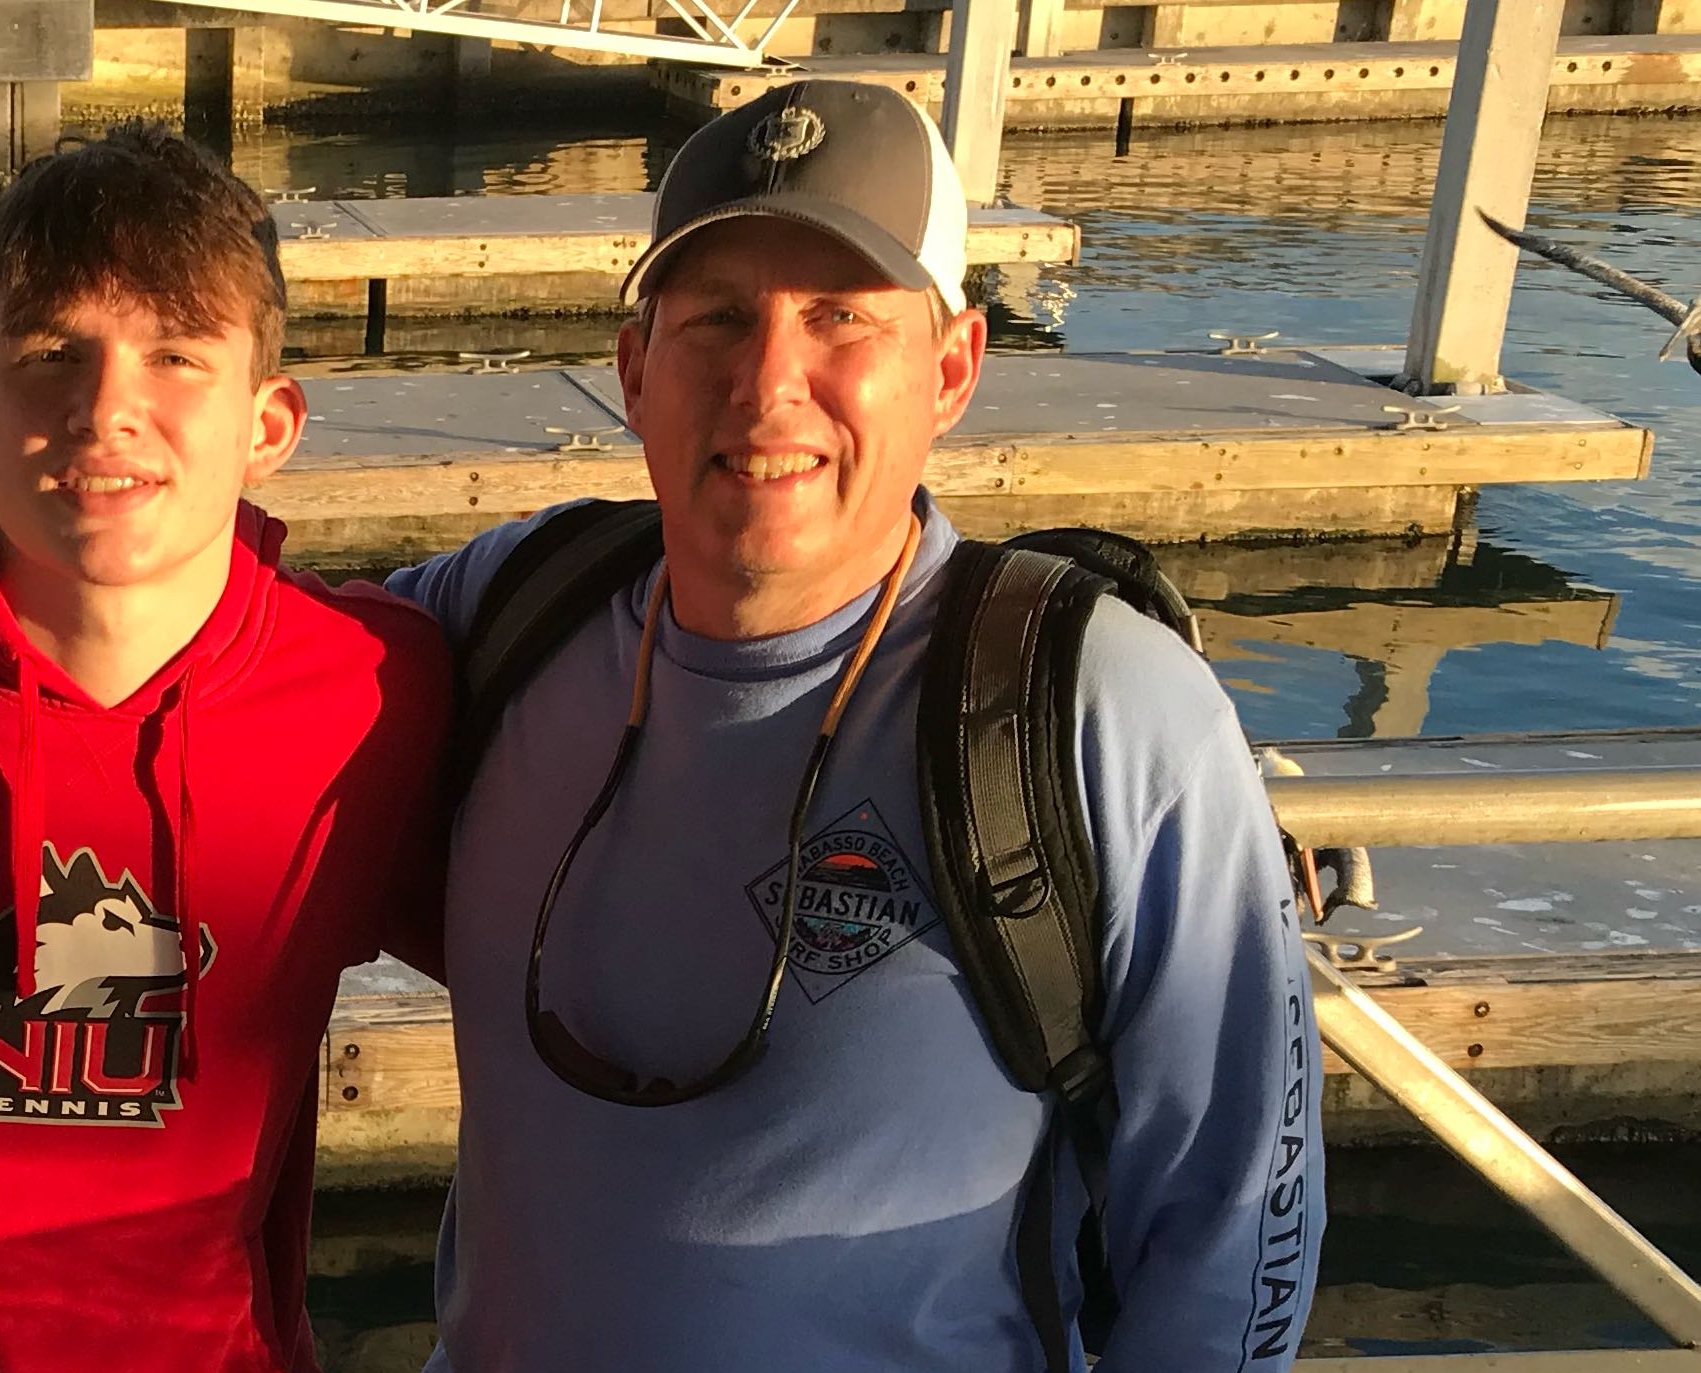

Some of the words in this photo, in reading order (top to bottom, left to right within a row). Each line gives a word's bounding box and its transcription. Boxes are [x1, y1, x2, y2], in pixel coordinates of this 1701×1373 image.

[797, 836, 865, 875] ABASSO
[868, 841, 910, 892] BEACH
[765, 882, 920, 927] SBASTIAN
[828, 928, 892, 970] SHOP
